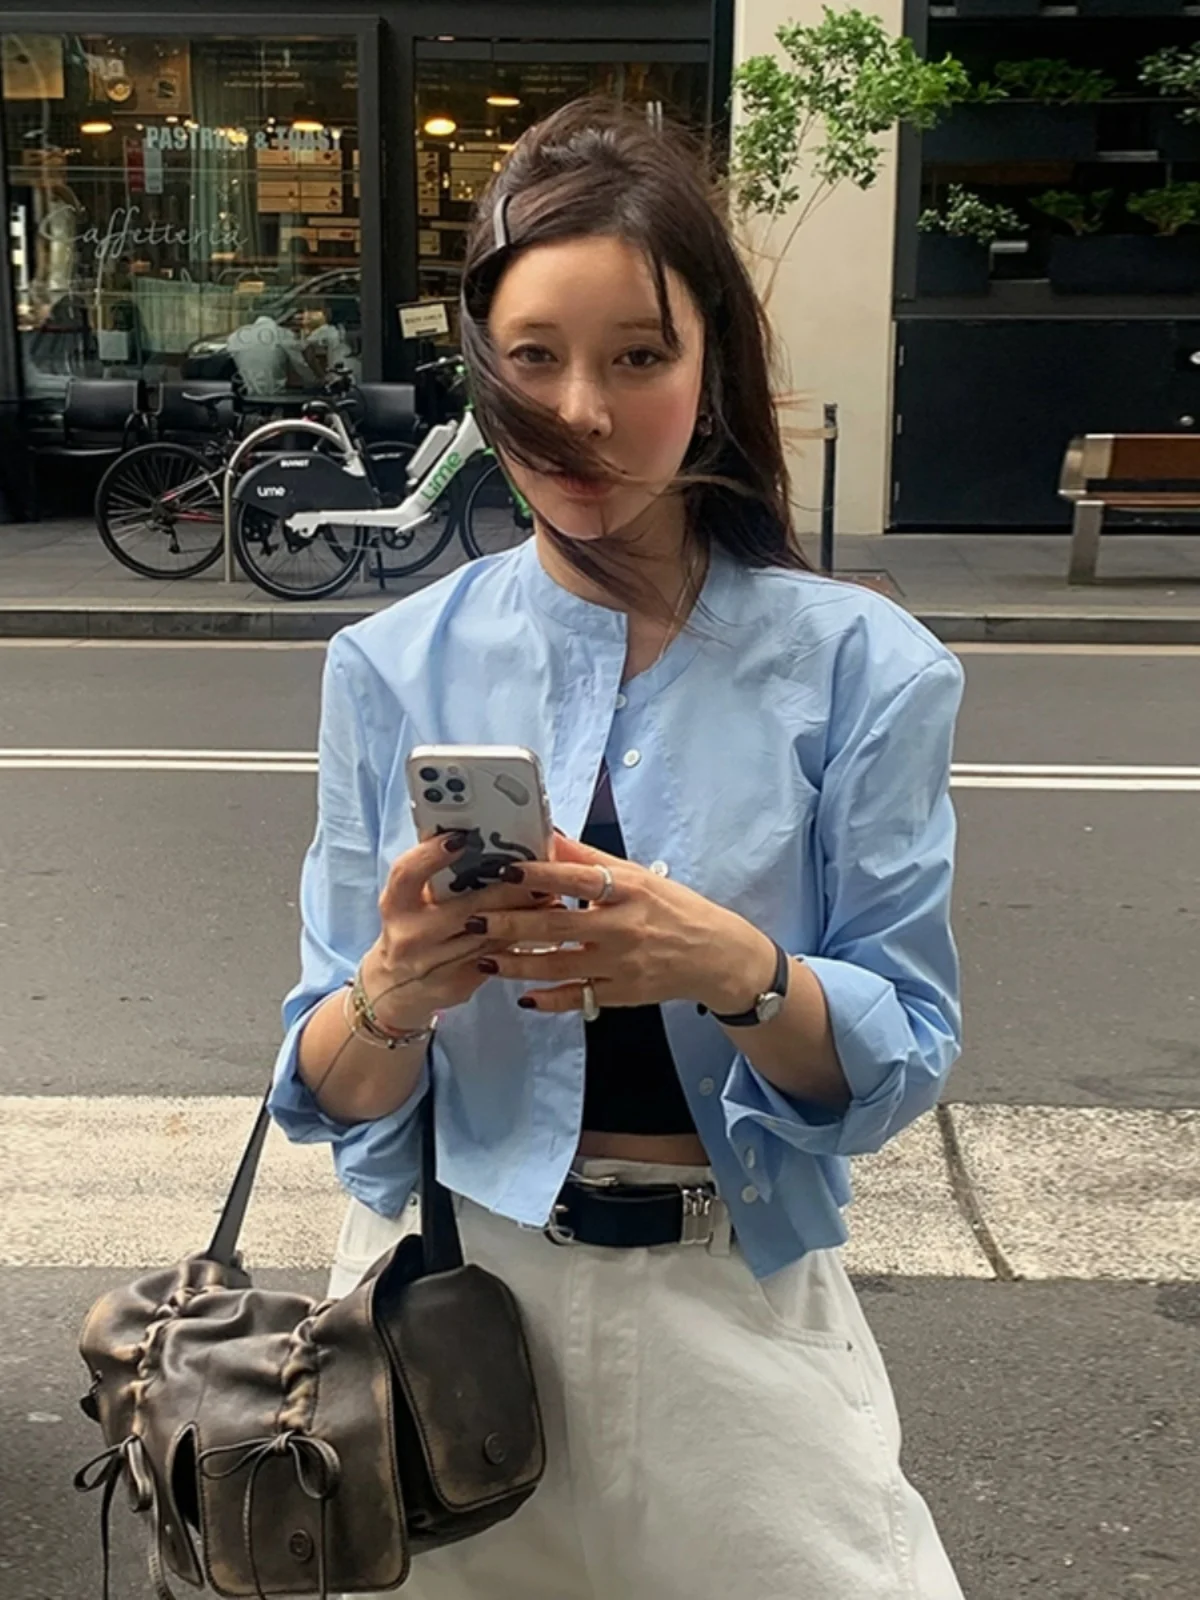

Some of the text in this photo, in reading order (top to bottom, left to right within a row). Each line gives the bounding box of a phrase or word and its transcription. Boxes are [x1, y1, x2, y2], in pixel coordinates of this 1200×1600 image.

[254, 131, 269, 150] &
[38, 205, 248, 259] Caffetteria
[421, 451, 462, 500] Lime
